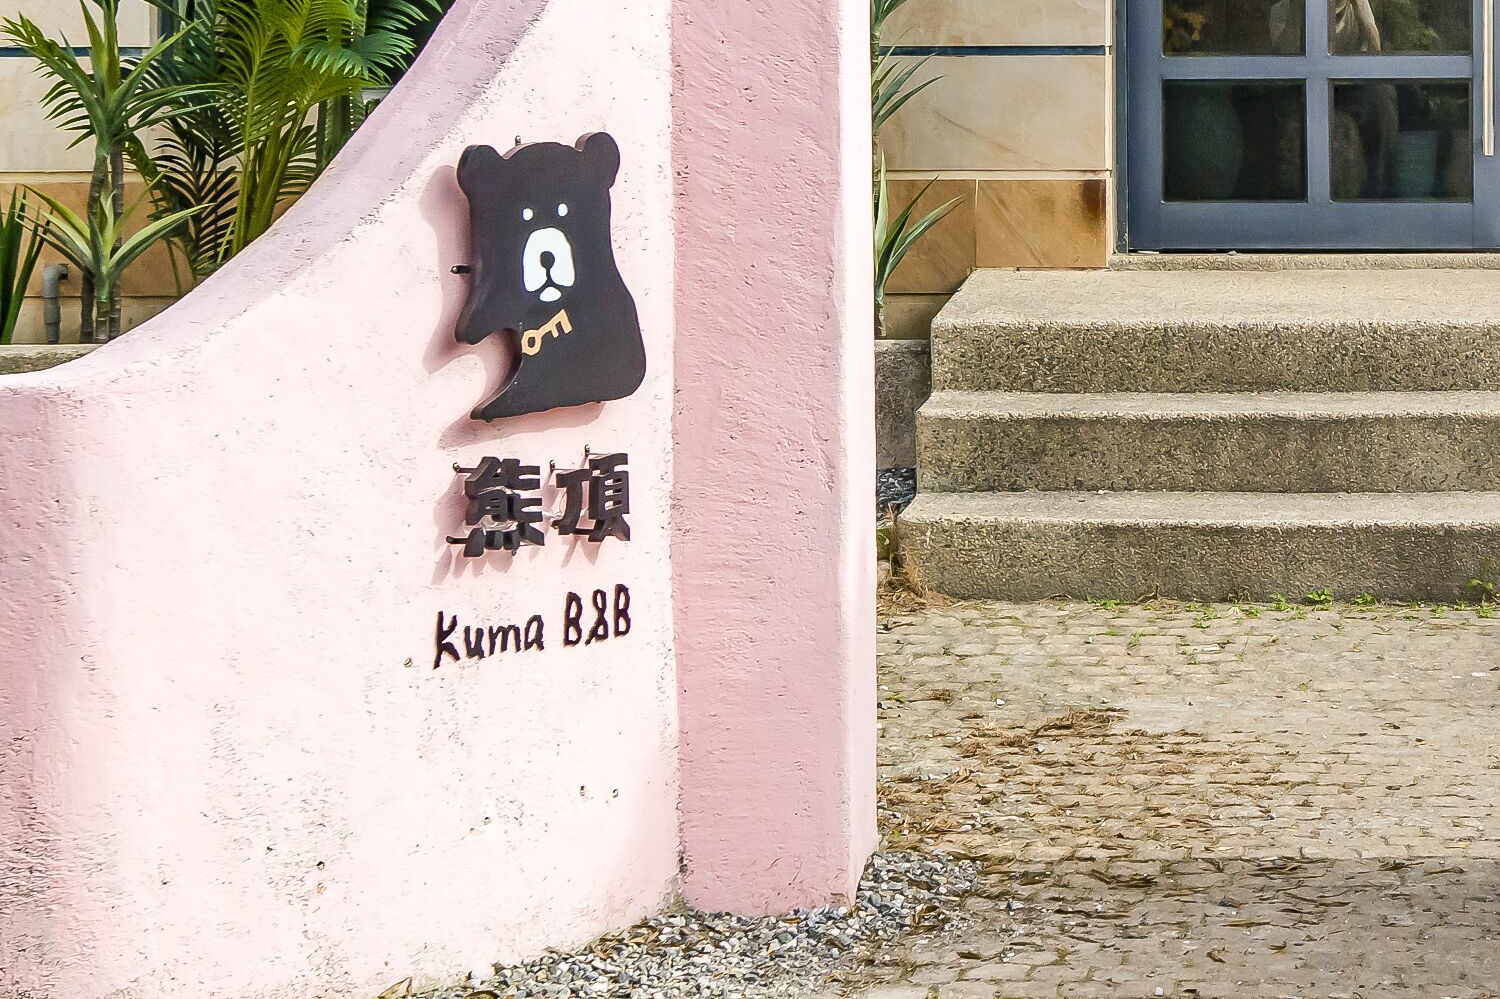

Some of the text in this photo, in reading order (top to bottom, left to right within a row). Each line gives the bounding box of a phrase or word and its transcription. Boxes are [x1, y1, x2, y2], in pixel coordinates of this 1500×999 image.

[463, 452, 631, 558] 熊頂
[432, 583, 632, 670] Kuma B&B
